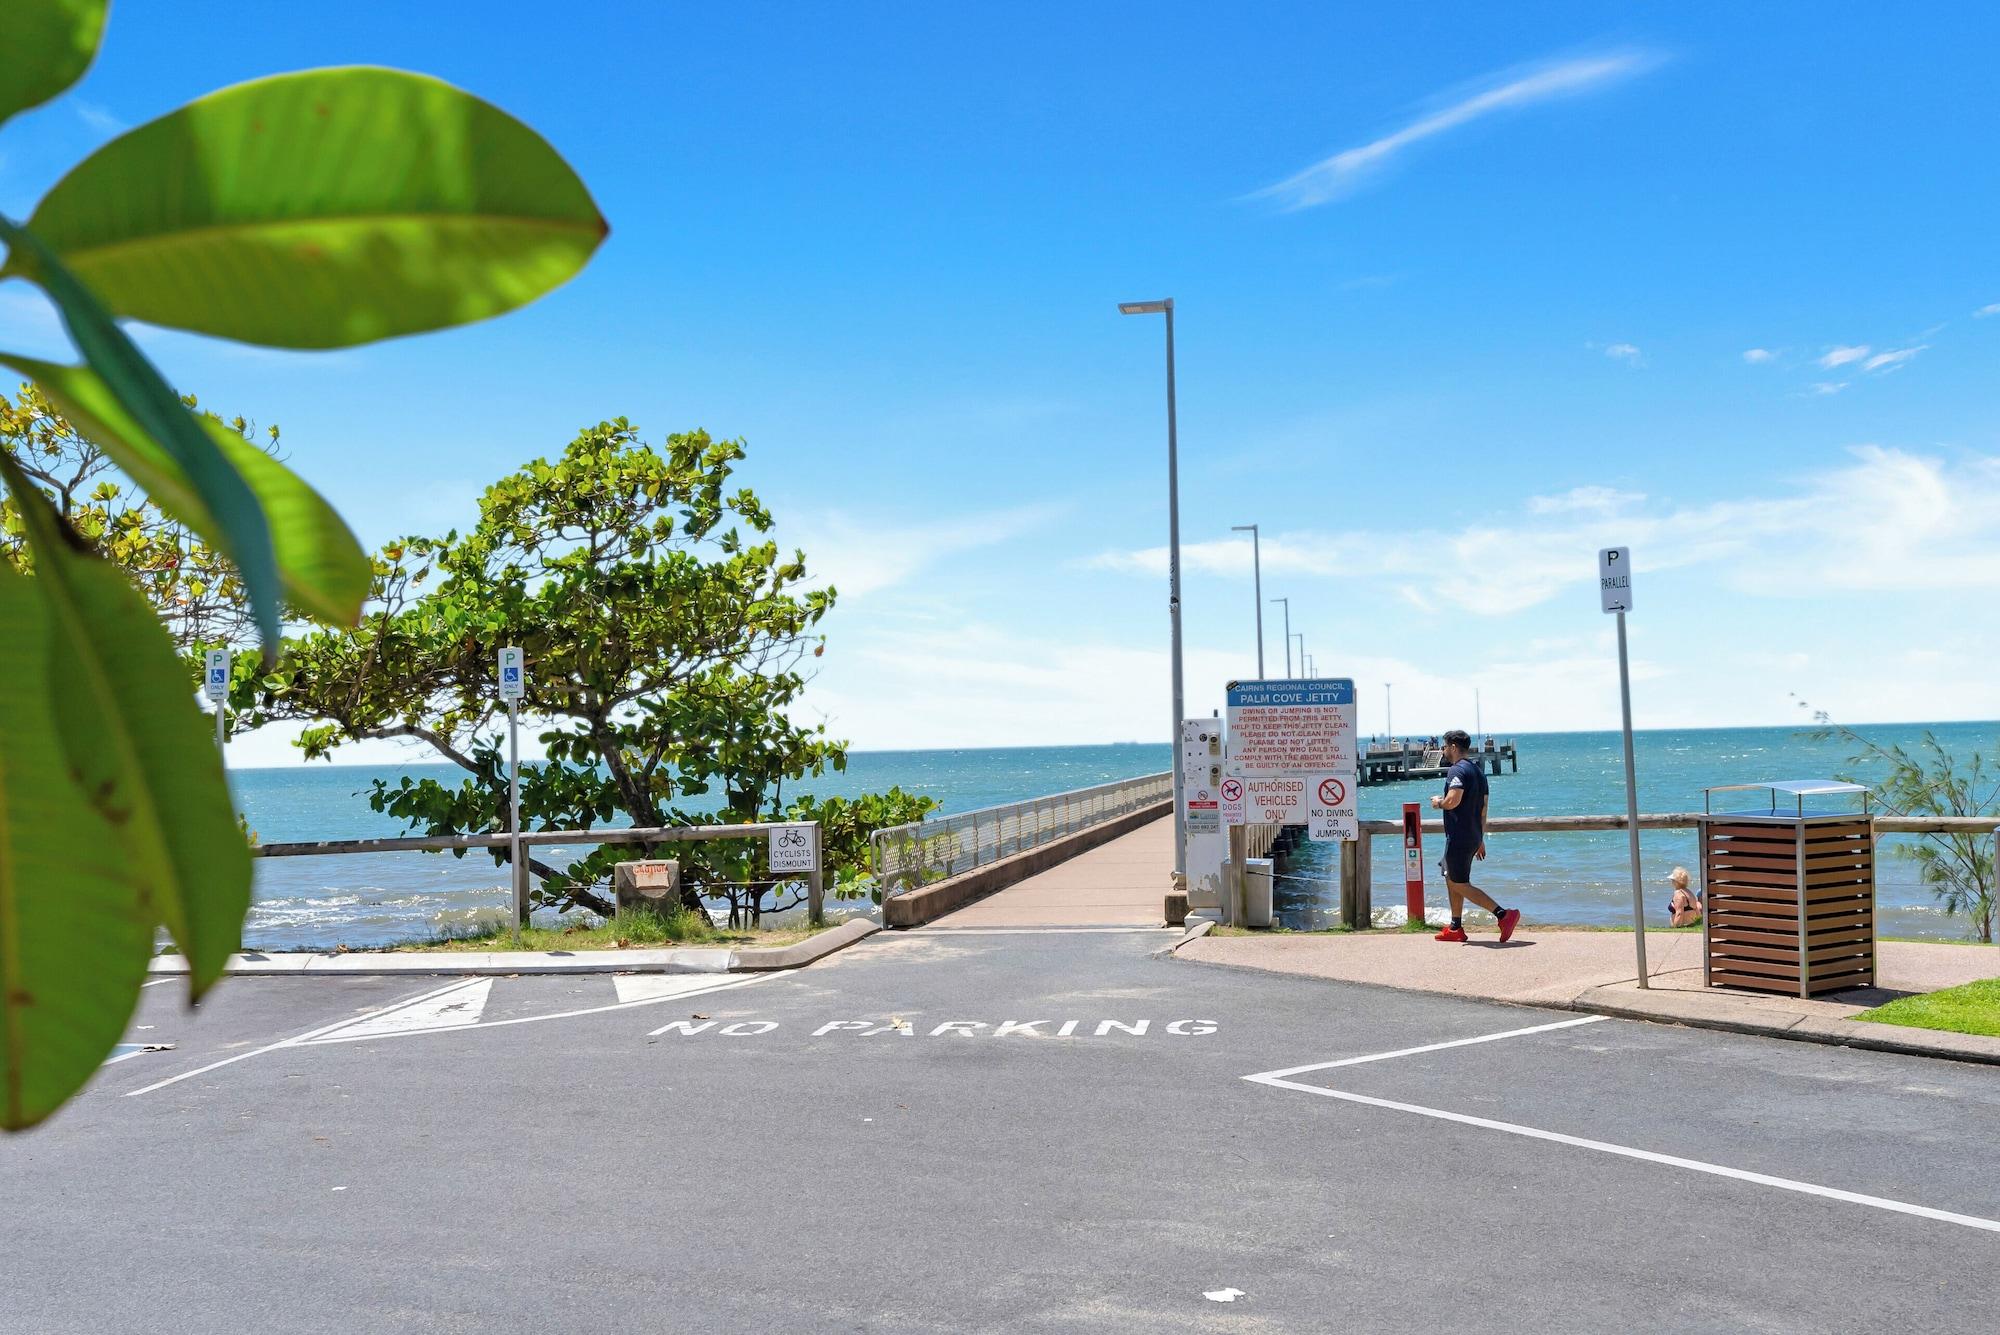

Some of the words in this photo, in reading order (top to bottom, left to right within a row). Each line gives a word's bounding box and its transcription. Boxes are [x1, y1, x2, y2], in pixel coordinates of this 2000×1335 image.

[1608, 551, 1619, 566] P
[1601, 576, 1629, 590] PARALLEL
[213, 655, 223, 666] P
[506, 653, 515, 664] P
[1235, 684, 1265, 692] CAIRNS
[1267, 682, 1306, 691] REGIONAL
[1241, 694, 1269, 703] PALM
[1273, 693, 1302, 702] COVE
[1306, 692, 1339, 702] JETTY
[1248, 782, 1304, 792] AUTHORISED
[1255, 796, 1297, 806] VEHICLES
[1222, 803, 1242, 811] DOGS
[1265, 810, 1287, 820] ONLY
[1311, 809, 1323, 817] NO
[1326, 809, 1353, 817] DIVING
[1327, 820, 1339, 828] OR
[1315, 830, 1351, 838] JUMPING
[773, 850, 811, 858] CYCLISTS
[773, 860, 811, 868] DISMOUNT
[647, 1021, 779, 1036] NO
[811, 1019, 1218, 1036] PARKING
